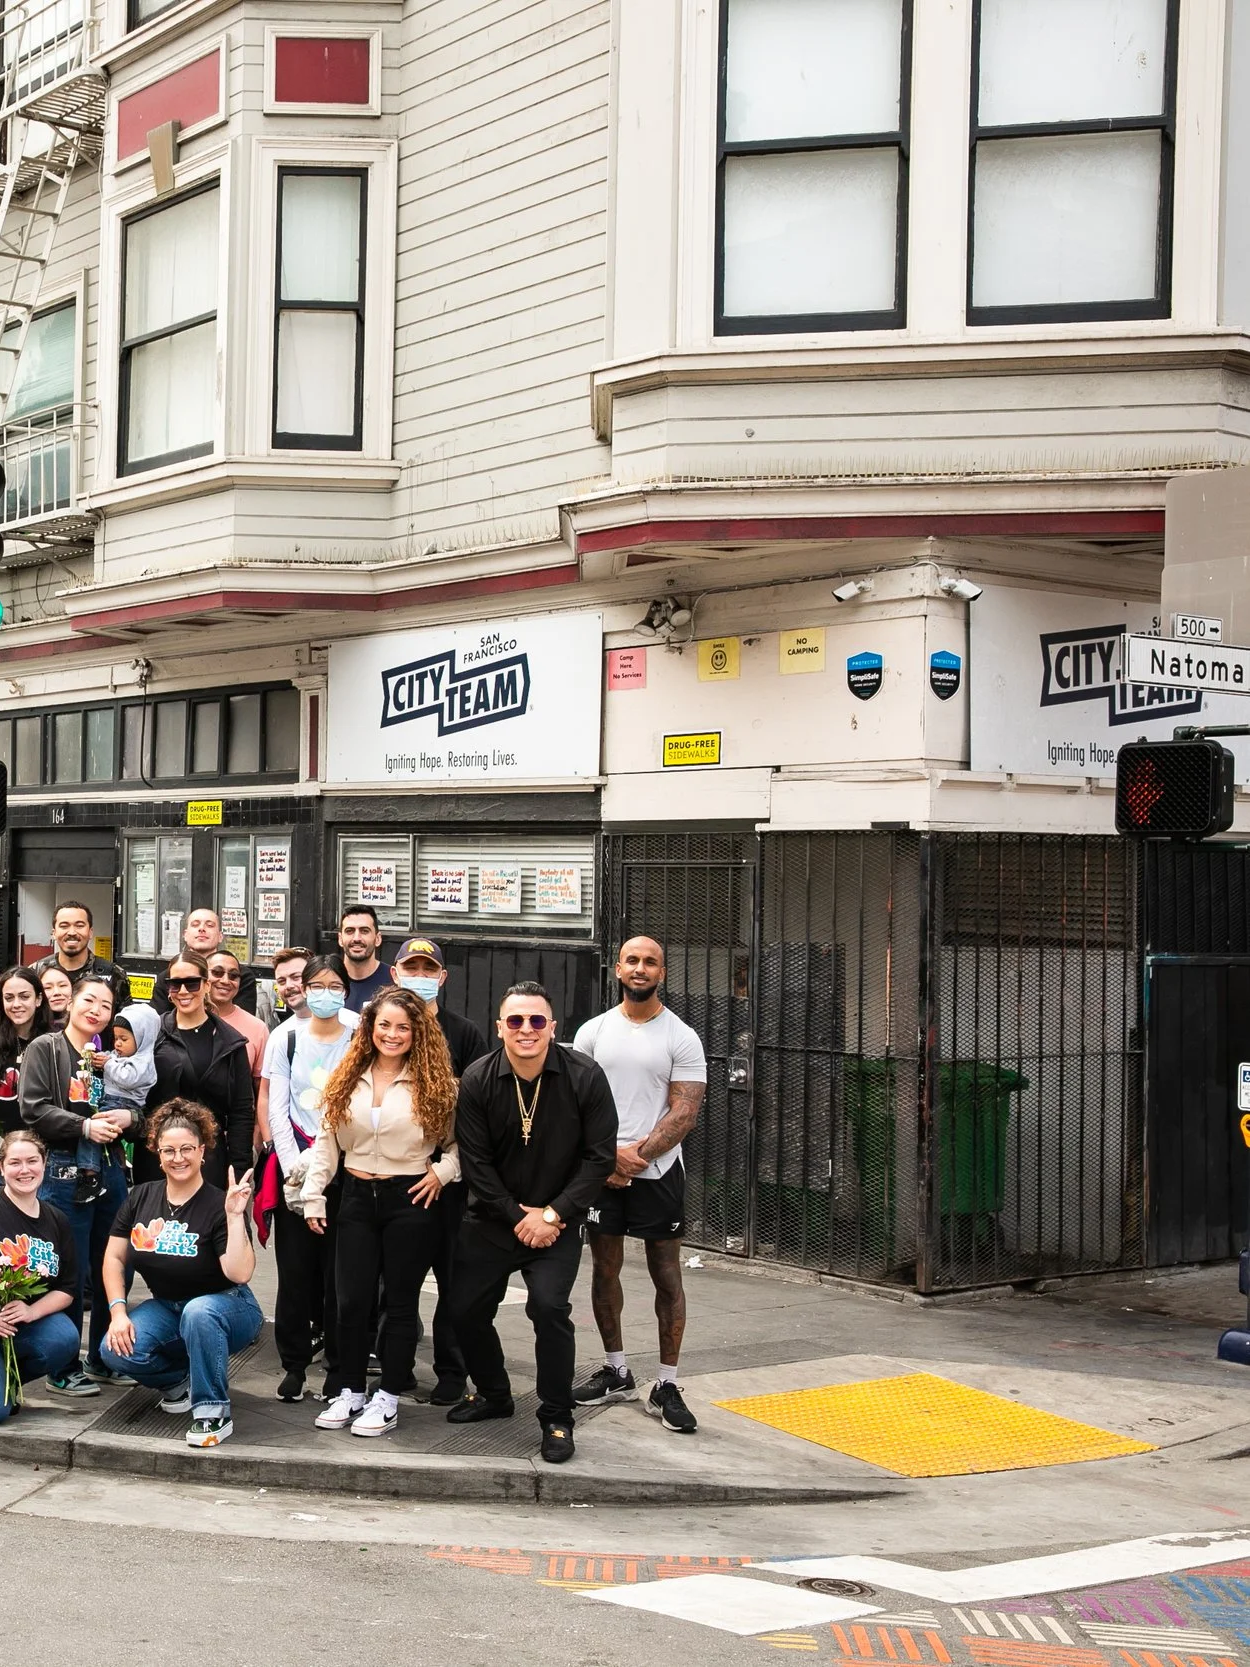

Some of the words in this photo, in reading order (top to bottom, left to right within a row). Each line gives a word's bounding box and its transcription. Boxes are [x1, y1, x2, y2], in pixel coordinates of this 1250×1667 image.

[1181, 618, 1206, 637] 500
[480, 632, 500, 648] SAN
[463, 639, 517, 664] FRANCISCO
[787, 646, 819, 656] CAMPING
[1054, 639, 1116, 690] CITY
[1151, 648, 1244, 684] Natoma
[850, 672, 879, 682] SimpliSafe
[932, 671, 957, 681] SimpliSafe
[393, 664, 445, 712] CITY
[445, 668, 518, 723] TEAM
[668, 739, 716, 750] DRUG-FREE
[385, 753, 416, 773] Igniting
[419, 751, 444, 772] Hope.
[447, 750, 488, 771] Restoring
[492, 749, 518, 766] Lives.
[668, 750, 715, 760] SIDEWALKS
[1047, 739, 1085, 767] Igniting
[1089, 742, 1117, 768] Hope.
[52, 808, 65, 824] 164
[190, 805, 220, 813] DRUG-FREE
[190, 813, 220, 821] SIDEWALKS
[128, 980, 152, 988] RUG-FREE
[165, 1221, 187, 1231] The
[30, 1238, 53, 1249] The
[160, 1230, 198, 1247] City
[156, 1241, 197, 1256] Eats
